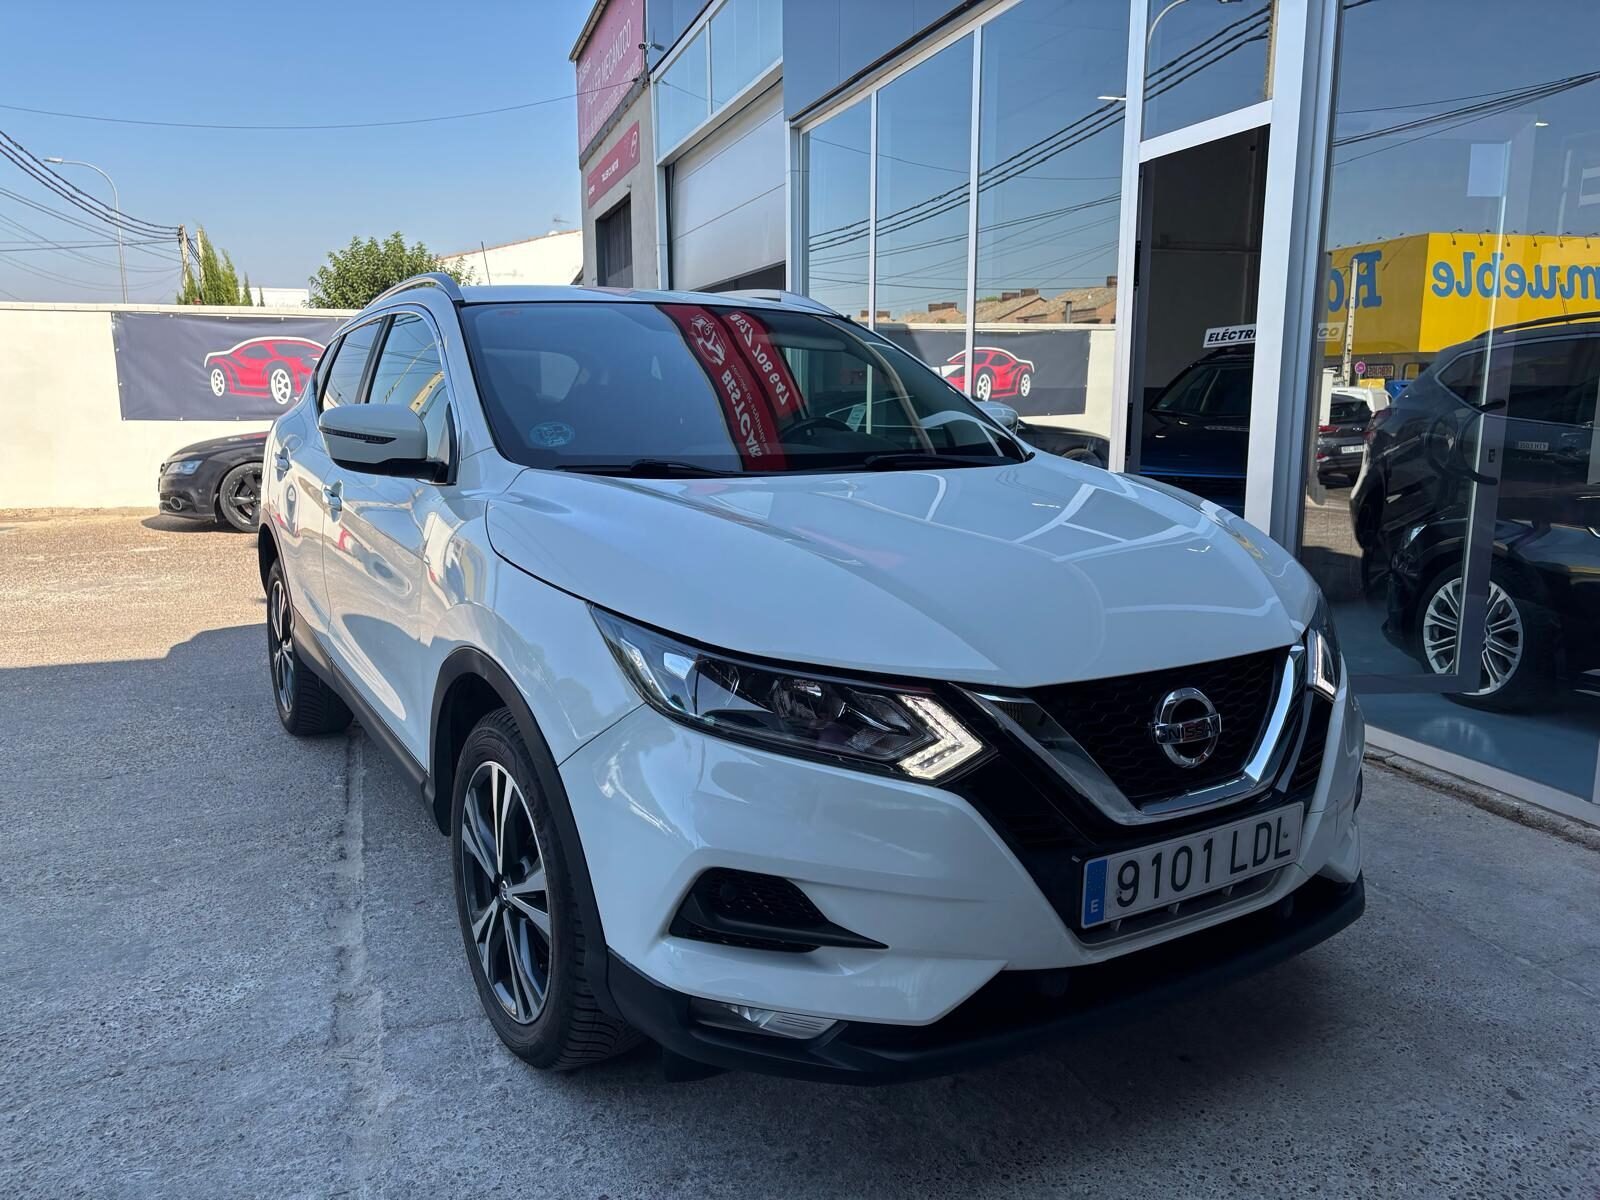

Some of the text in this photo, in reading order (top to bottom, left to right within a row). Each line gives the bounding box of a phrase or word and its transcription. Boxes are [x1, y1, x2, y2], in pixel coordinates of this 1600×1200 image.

[1207, 328, 1257, 343] ELÉCTRI
[1168, 716, 1219, 740] NISSAN
[1090, 816, 1291, 914] E 9101 LDL
